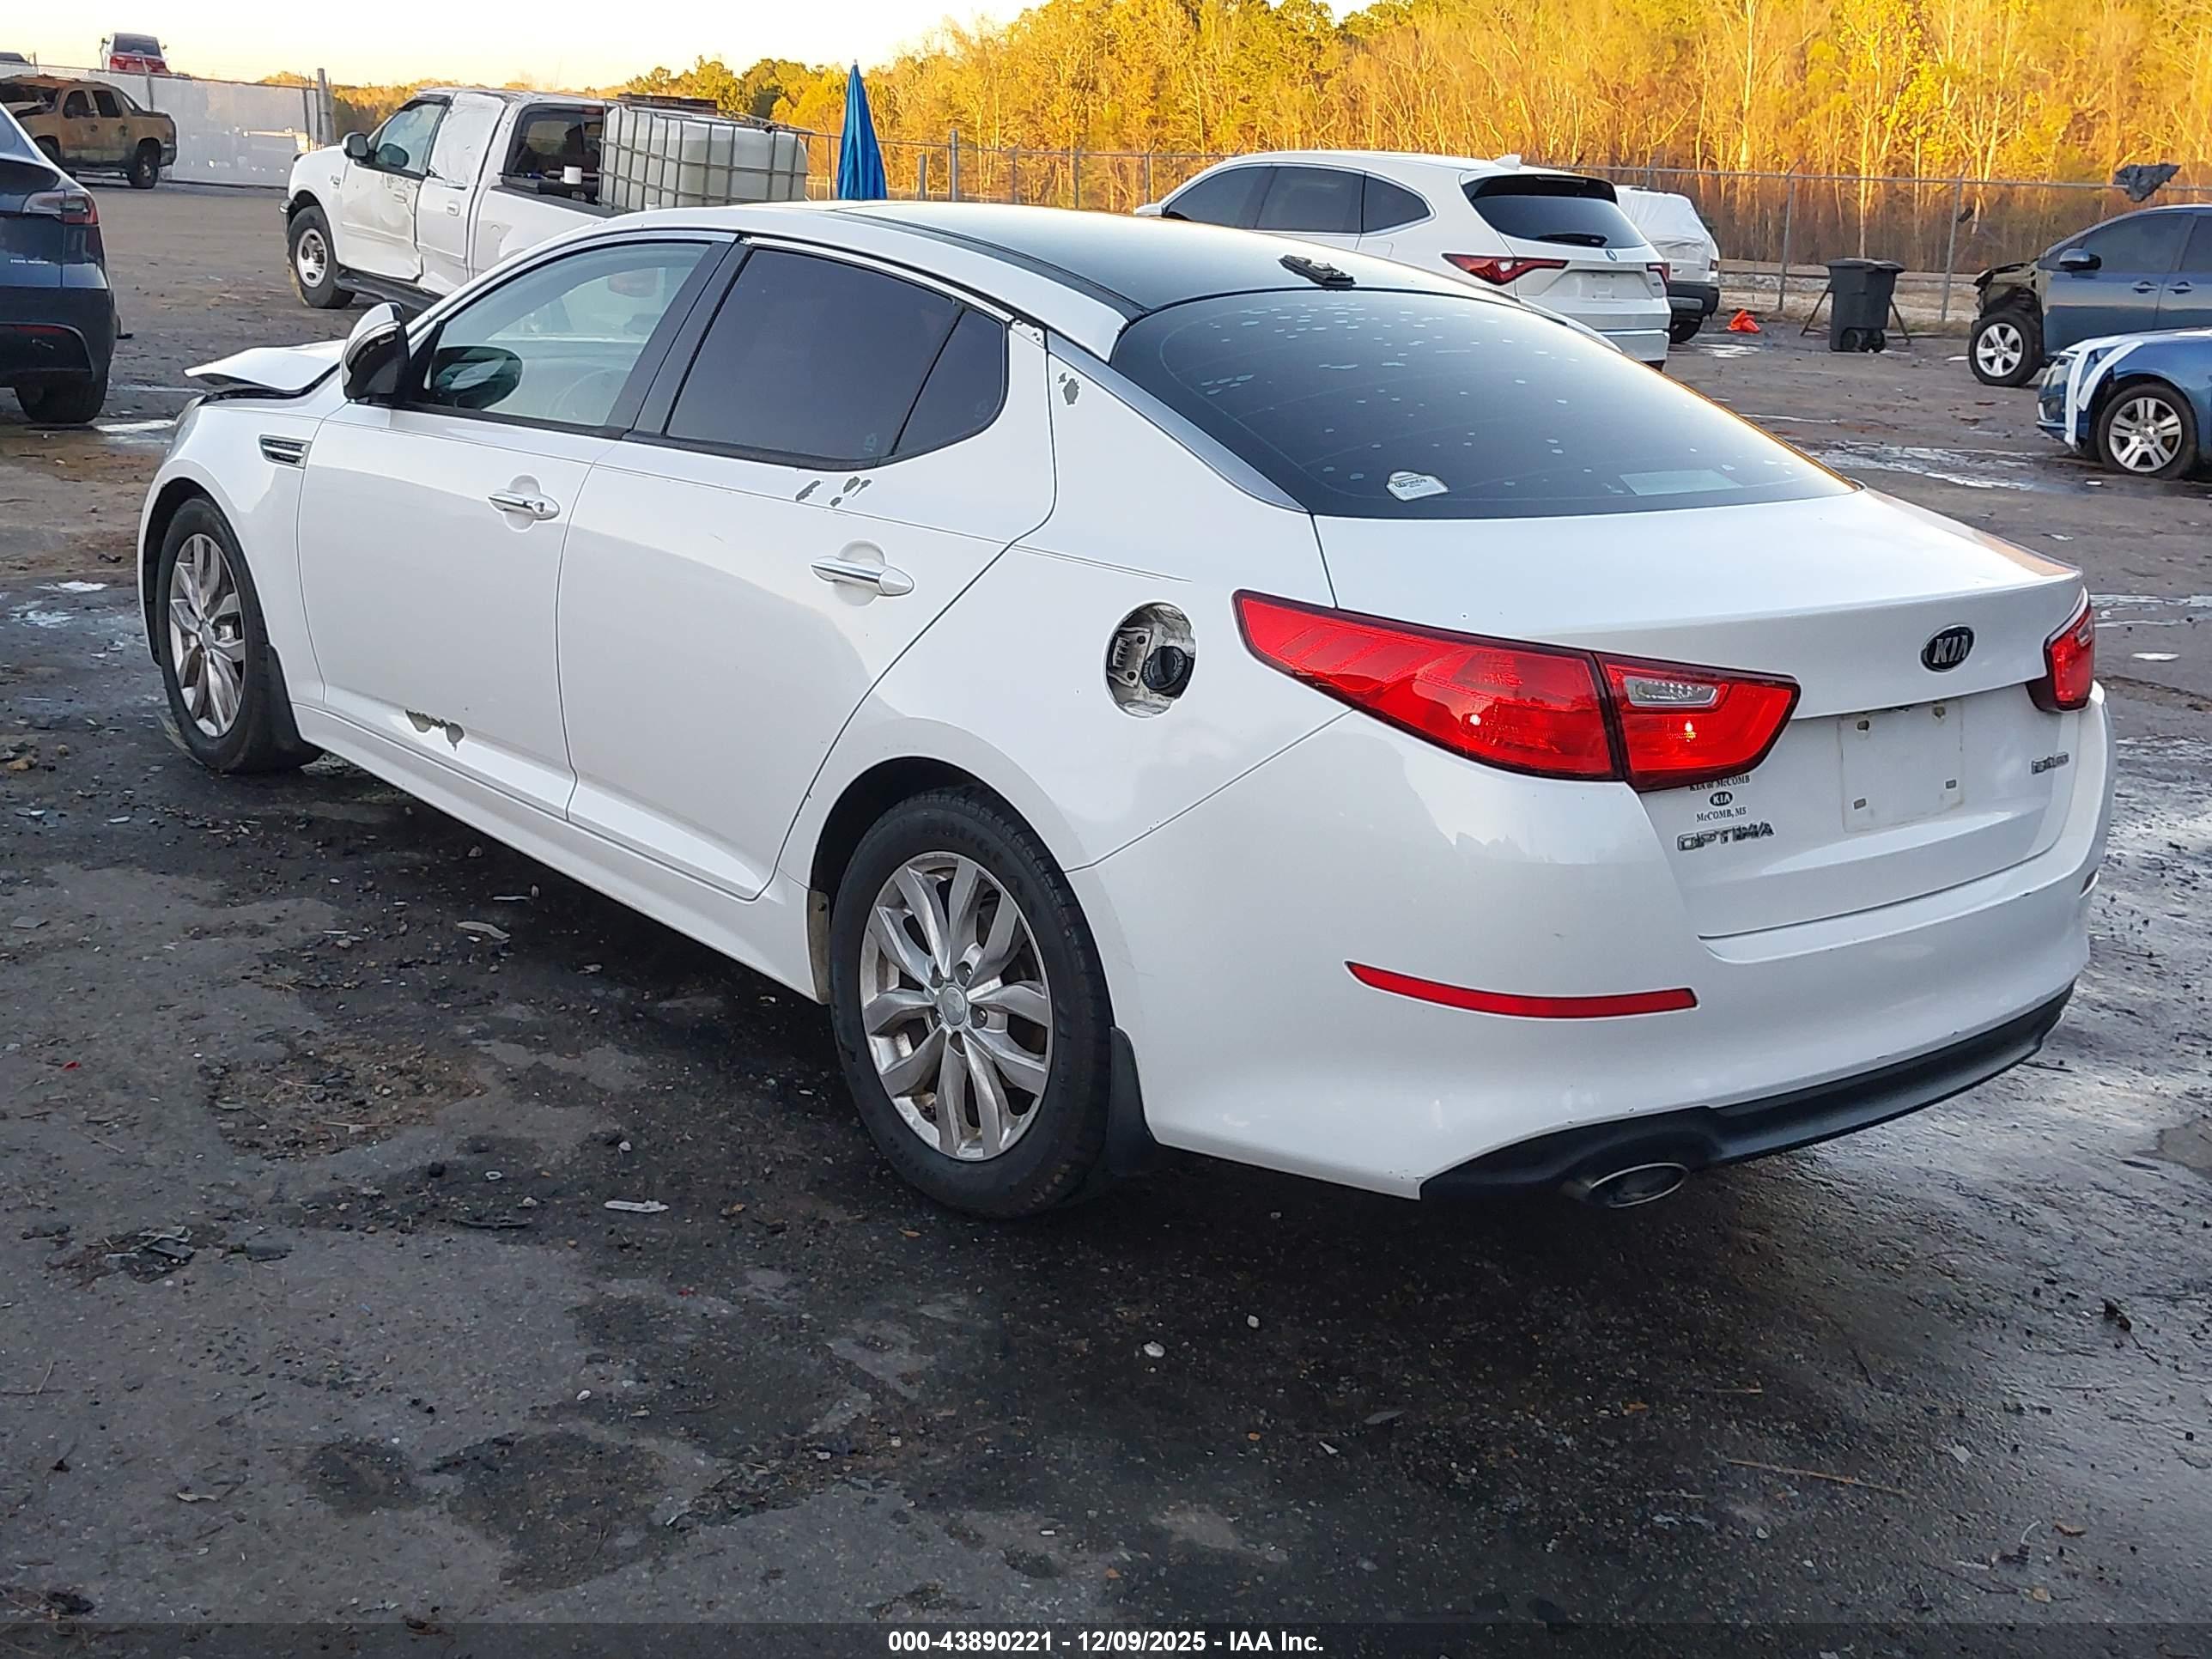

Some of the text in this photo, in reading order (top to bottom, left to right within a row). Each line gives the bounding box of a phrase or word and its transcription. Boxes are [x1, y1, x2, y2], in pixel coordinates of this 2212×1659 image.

[1931, 635, 1969, 664] KIA
[1712, 793, 1731, 805] KIA
[1696, 806, 1747, 822] McCOMB, MS
[1677, 822, 1774, 851] OPTIMA
